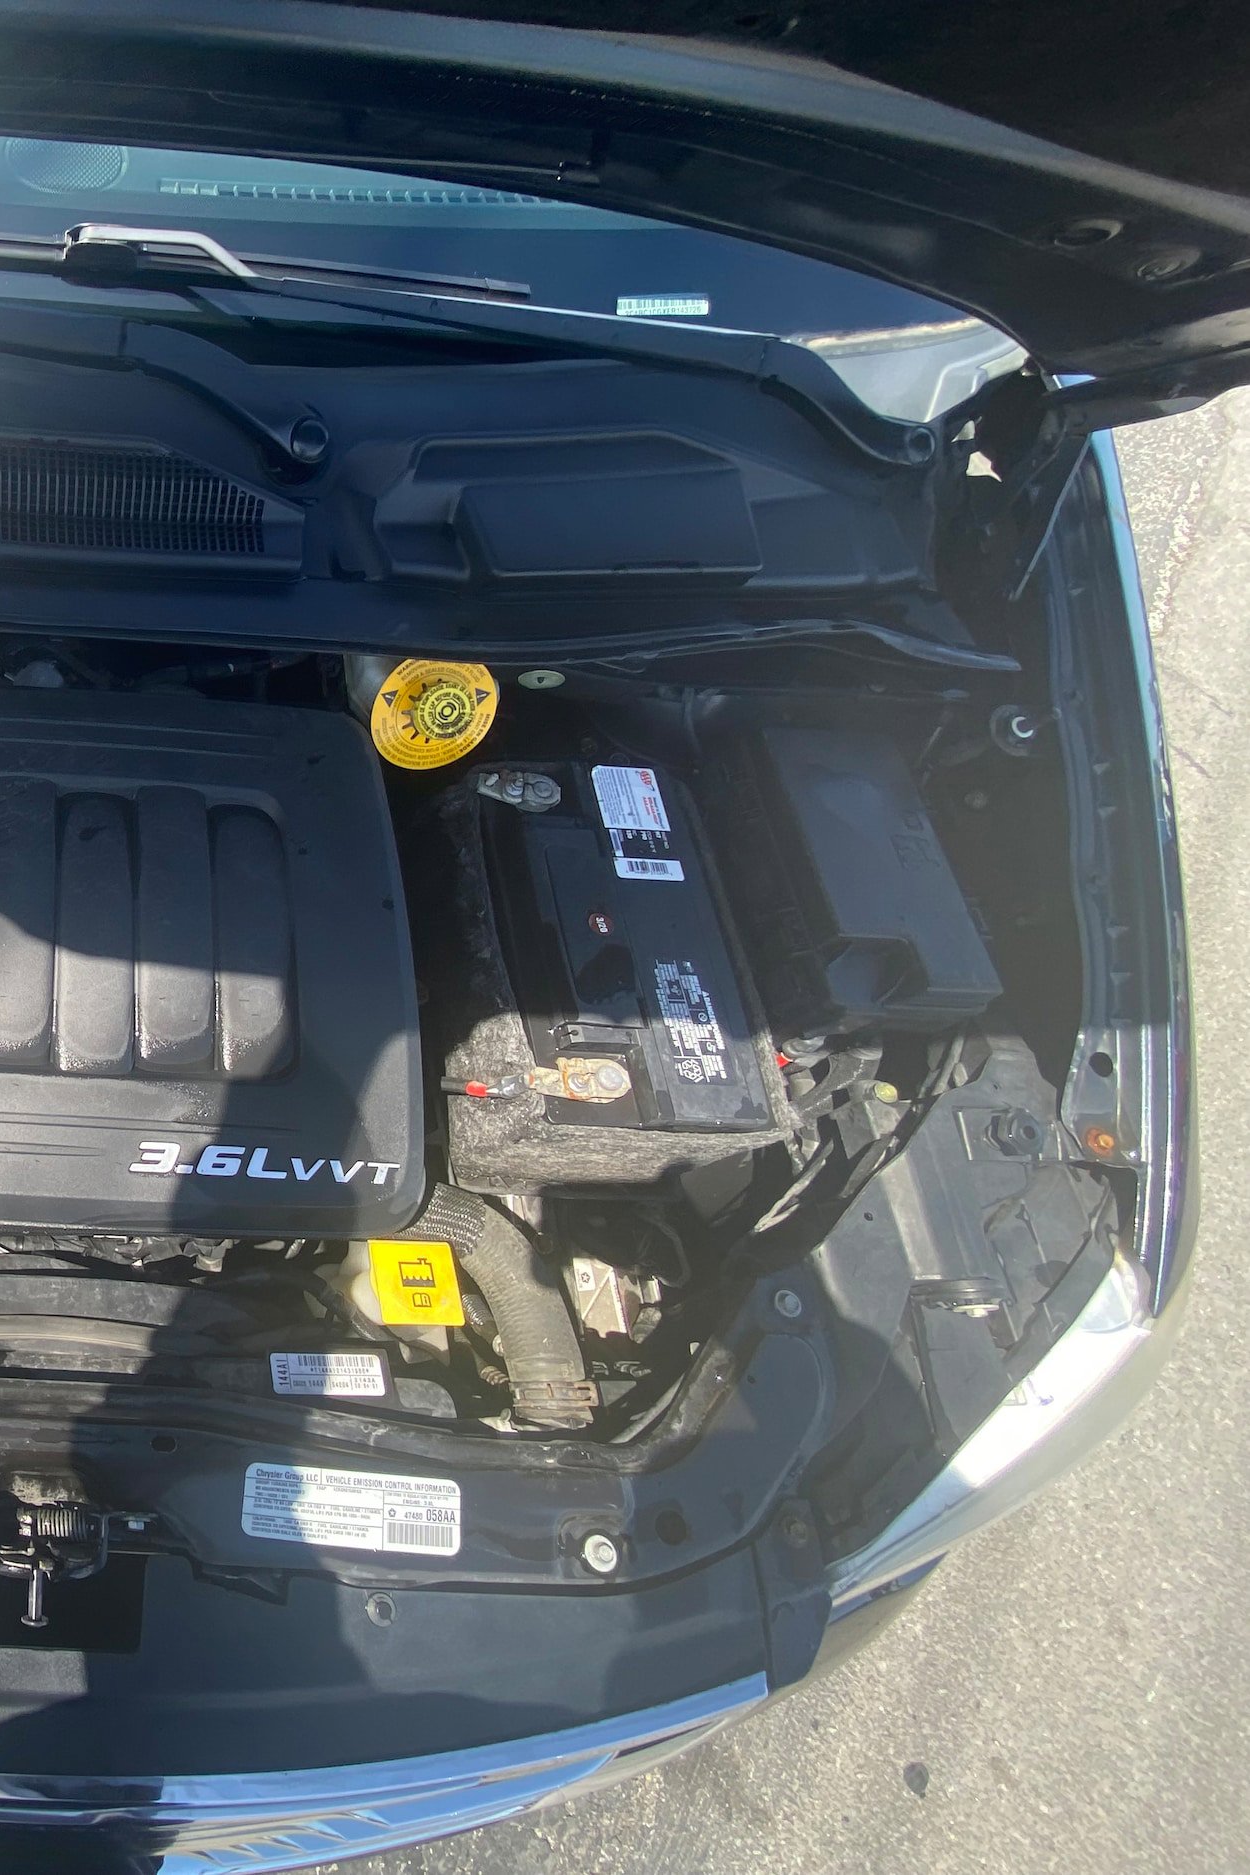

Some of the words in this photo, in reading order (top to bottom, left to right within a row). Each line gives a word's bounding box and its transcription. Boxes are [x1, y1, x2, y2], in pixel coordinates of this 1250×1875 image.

[595, 916, 609, 933] 3/20
[128, 1141, 288, 1180] 3.6L
[290, 1157, 401, 1185] VVT
[255, 1468, 283, 1479] Chrysler
[284, 1471, 305, 1482] Group
[306, 1474, 318, 1482] LLC
[325, 1475, 351, 1486] VEHICLE
[353, 1477, 383, 1489] EMISSION
[384, 1480, 412, 1491] CONTROL
[414, 1482, 457, 1495] INFORMATION
[425, 1508, 456, 1523] 058AA
